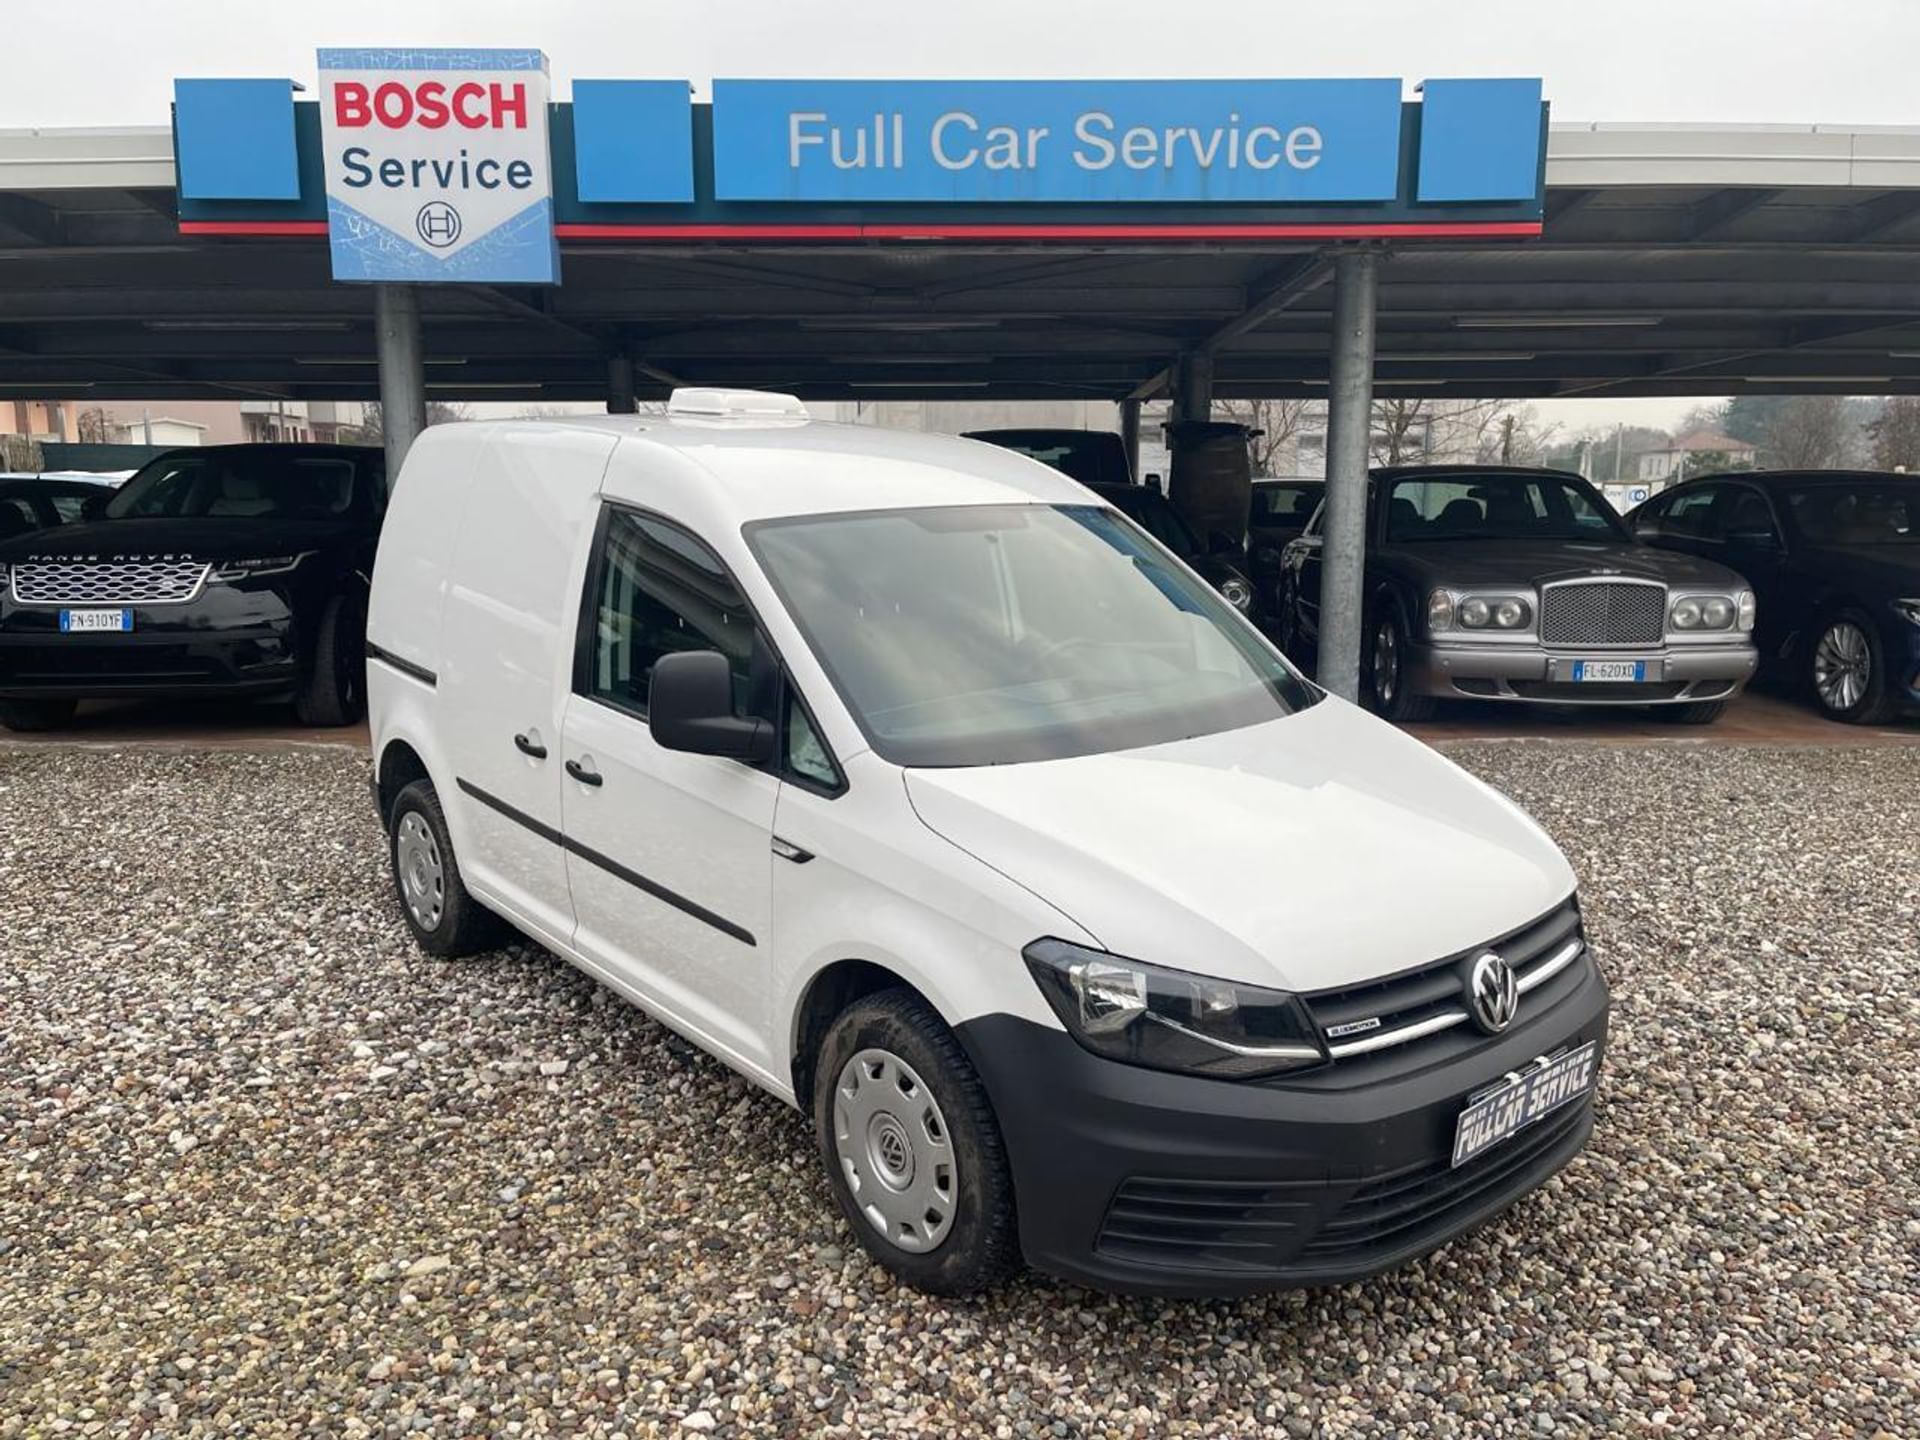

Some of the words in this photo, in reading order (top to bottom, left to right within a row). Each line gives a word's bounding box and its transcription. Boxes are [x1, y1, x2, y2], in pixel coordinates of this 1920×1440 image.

[334, 81, 527, 129] BOSCH
[789, 112, 904, 169] Full
[930, 111, 1049, 171] Car
[1072, 111, 1324, 171] Service
[342, 147, 533, 190] Service
[1527, 1047, 1595, 1117] SERVICE
